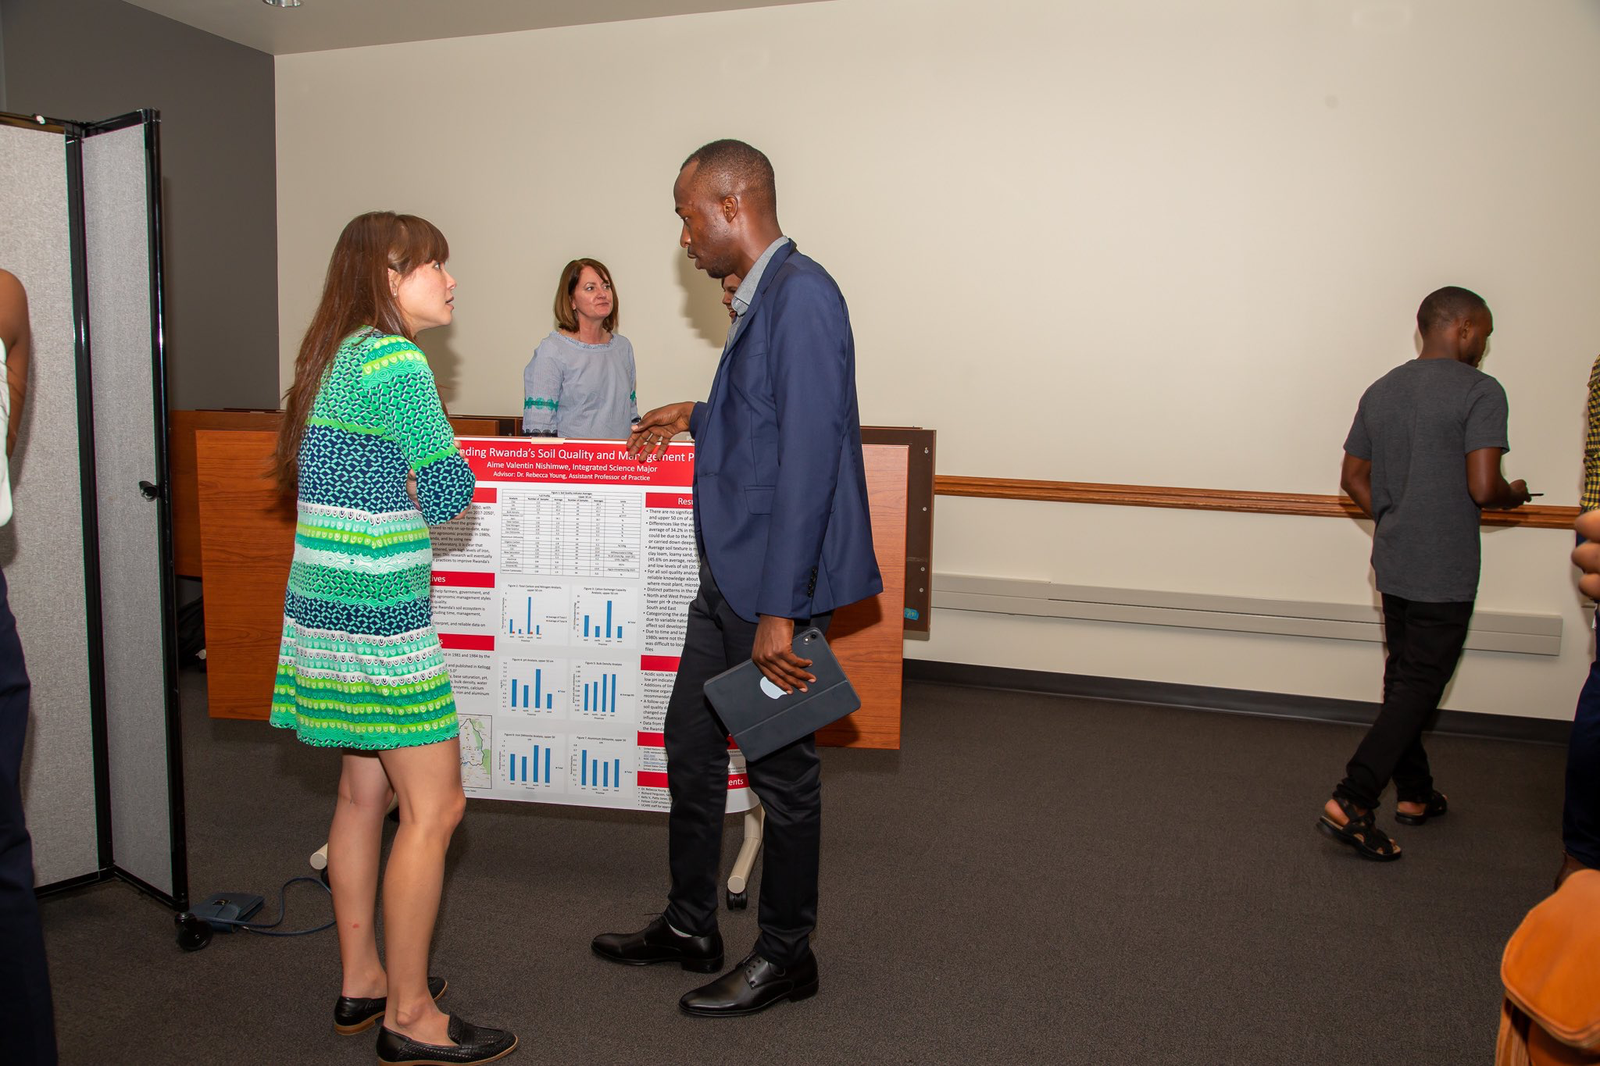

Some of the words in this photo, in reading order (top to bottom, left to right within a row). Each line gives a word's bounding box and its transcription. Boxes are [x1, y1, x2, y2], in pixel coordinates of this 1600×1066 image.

[489, 448, 535, 458] Rwanda's
[538, 449, 555, 458] Soil
[558, 449, 592, 461] Quality
[596, 450, 615, 460] and
[535, 462, 570, 471] Nishimwe,
[637, 465, 657, 473] Major
